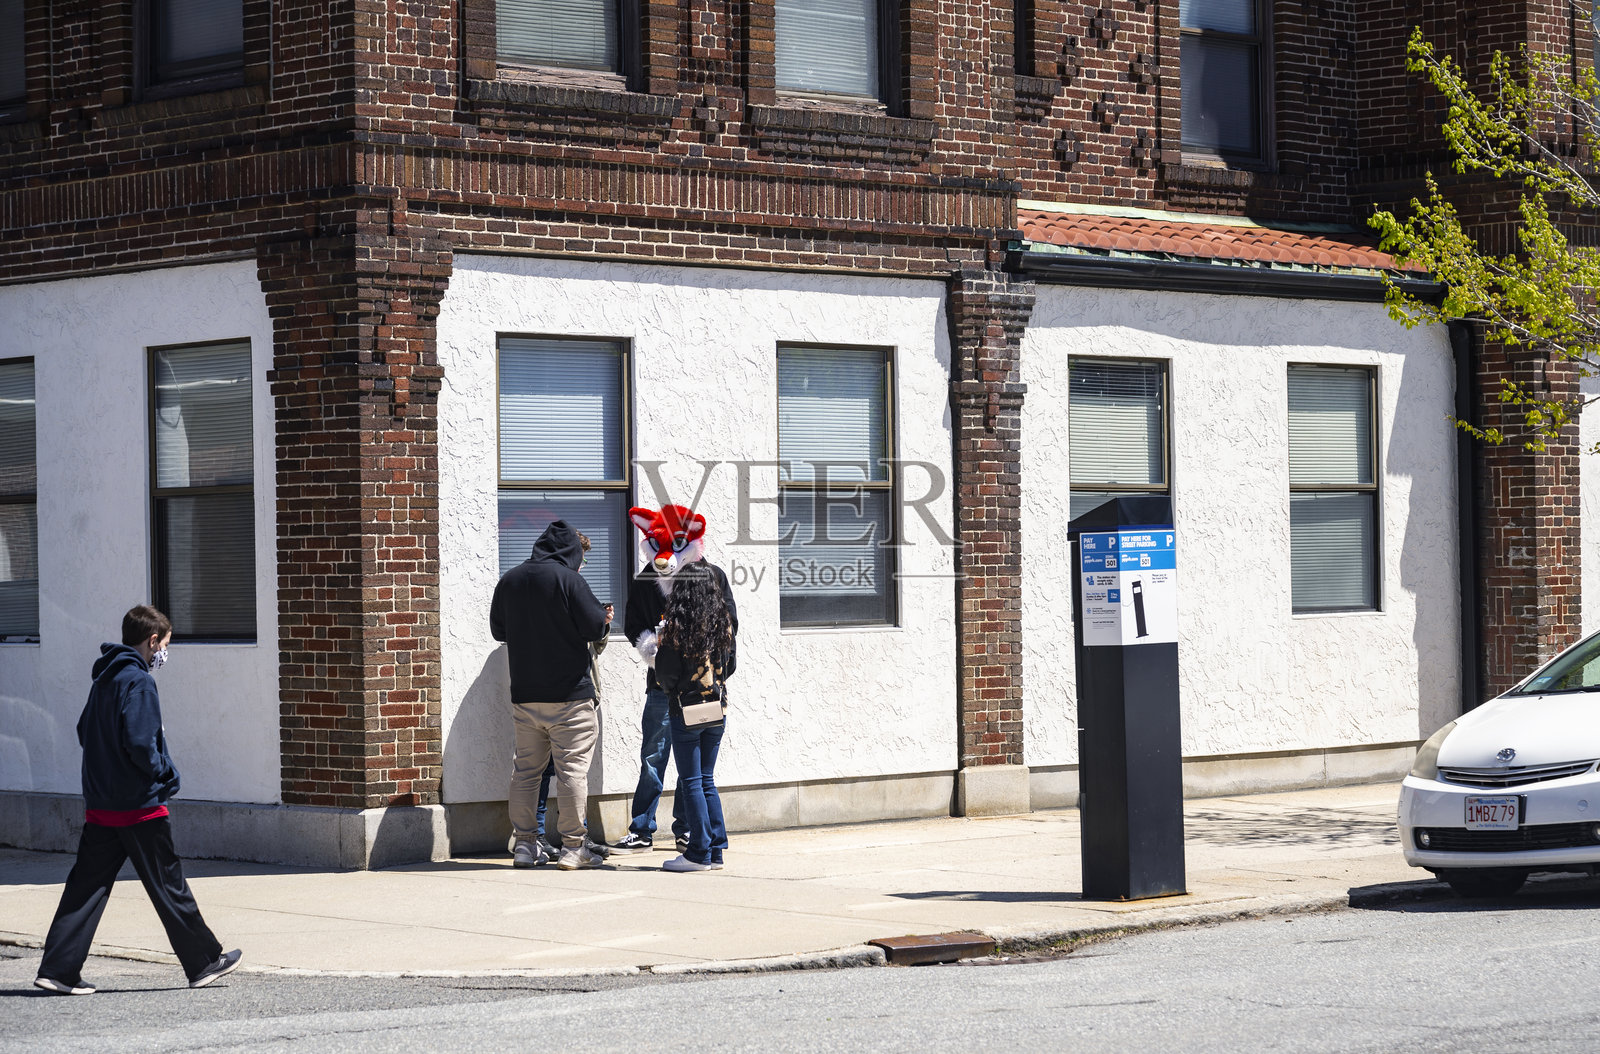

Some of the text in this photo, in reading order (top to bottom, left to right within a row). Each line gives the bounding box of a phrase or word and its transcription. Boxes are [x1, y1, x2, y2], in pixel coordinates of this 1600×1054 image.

[1109, 537, 1116, 549] P
[1166, 535, 1173, 547] P
[1468, 805, 1515, 822] 1MBZ 79
